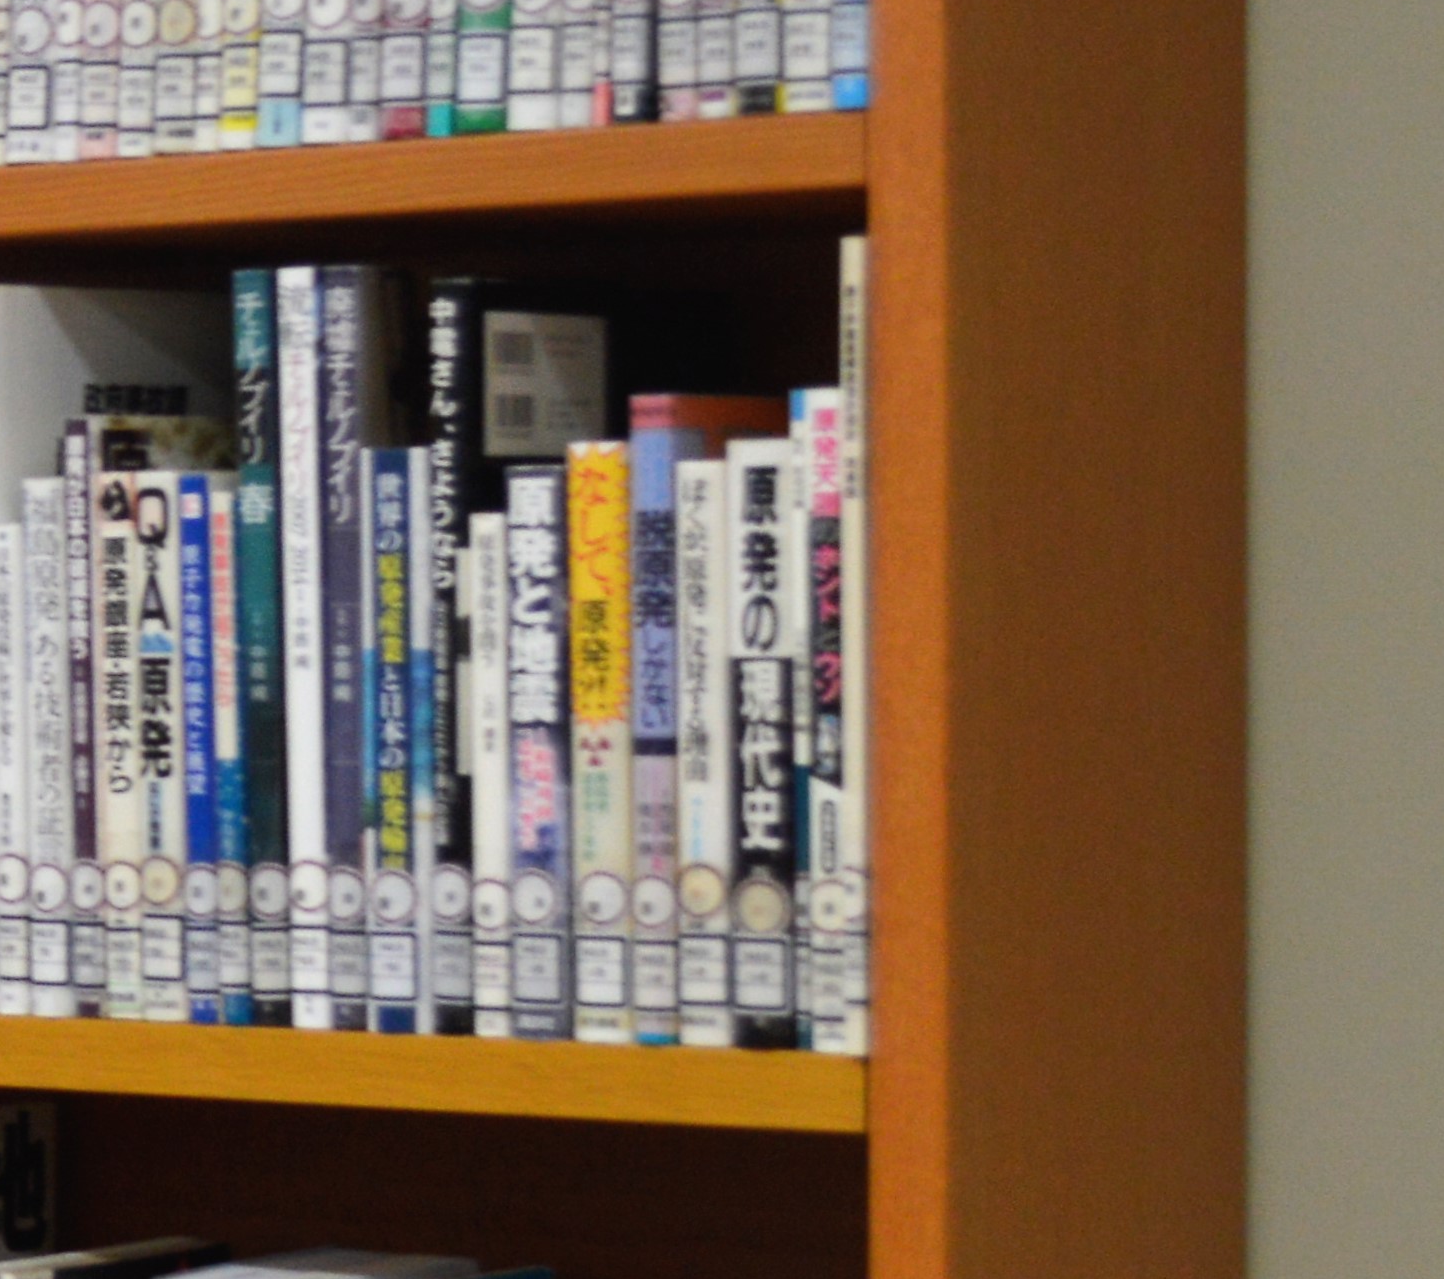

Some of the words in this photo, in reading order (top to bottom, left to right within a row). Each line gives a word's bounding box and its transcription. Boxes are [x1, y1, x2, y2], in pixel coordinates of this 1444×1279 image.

[730, 466, 787, 850] 原発の現代史
